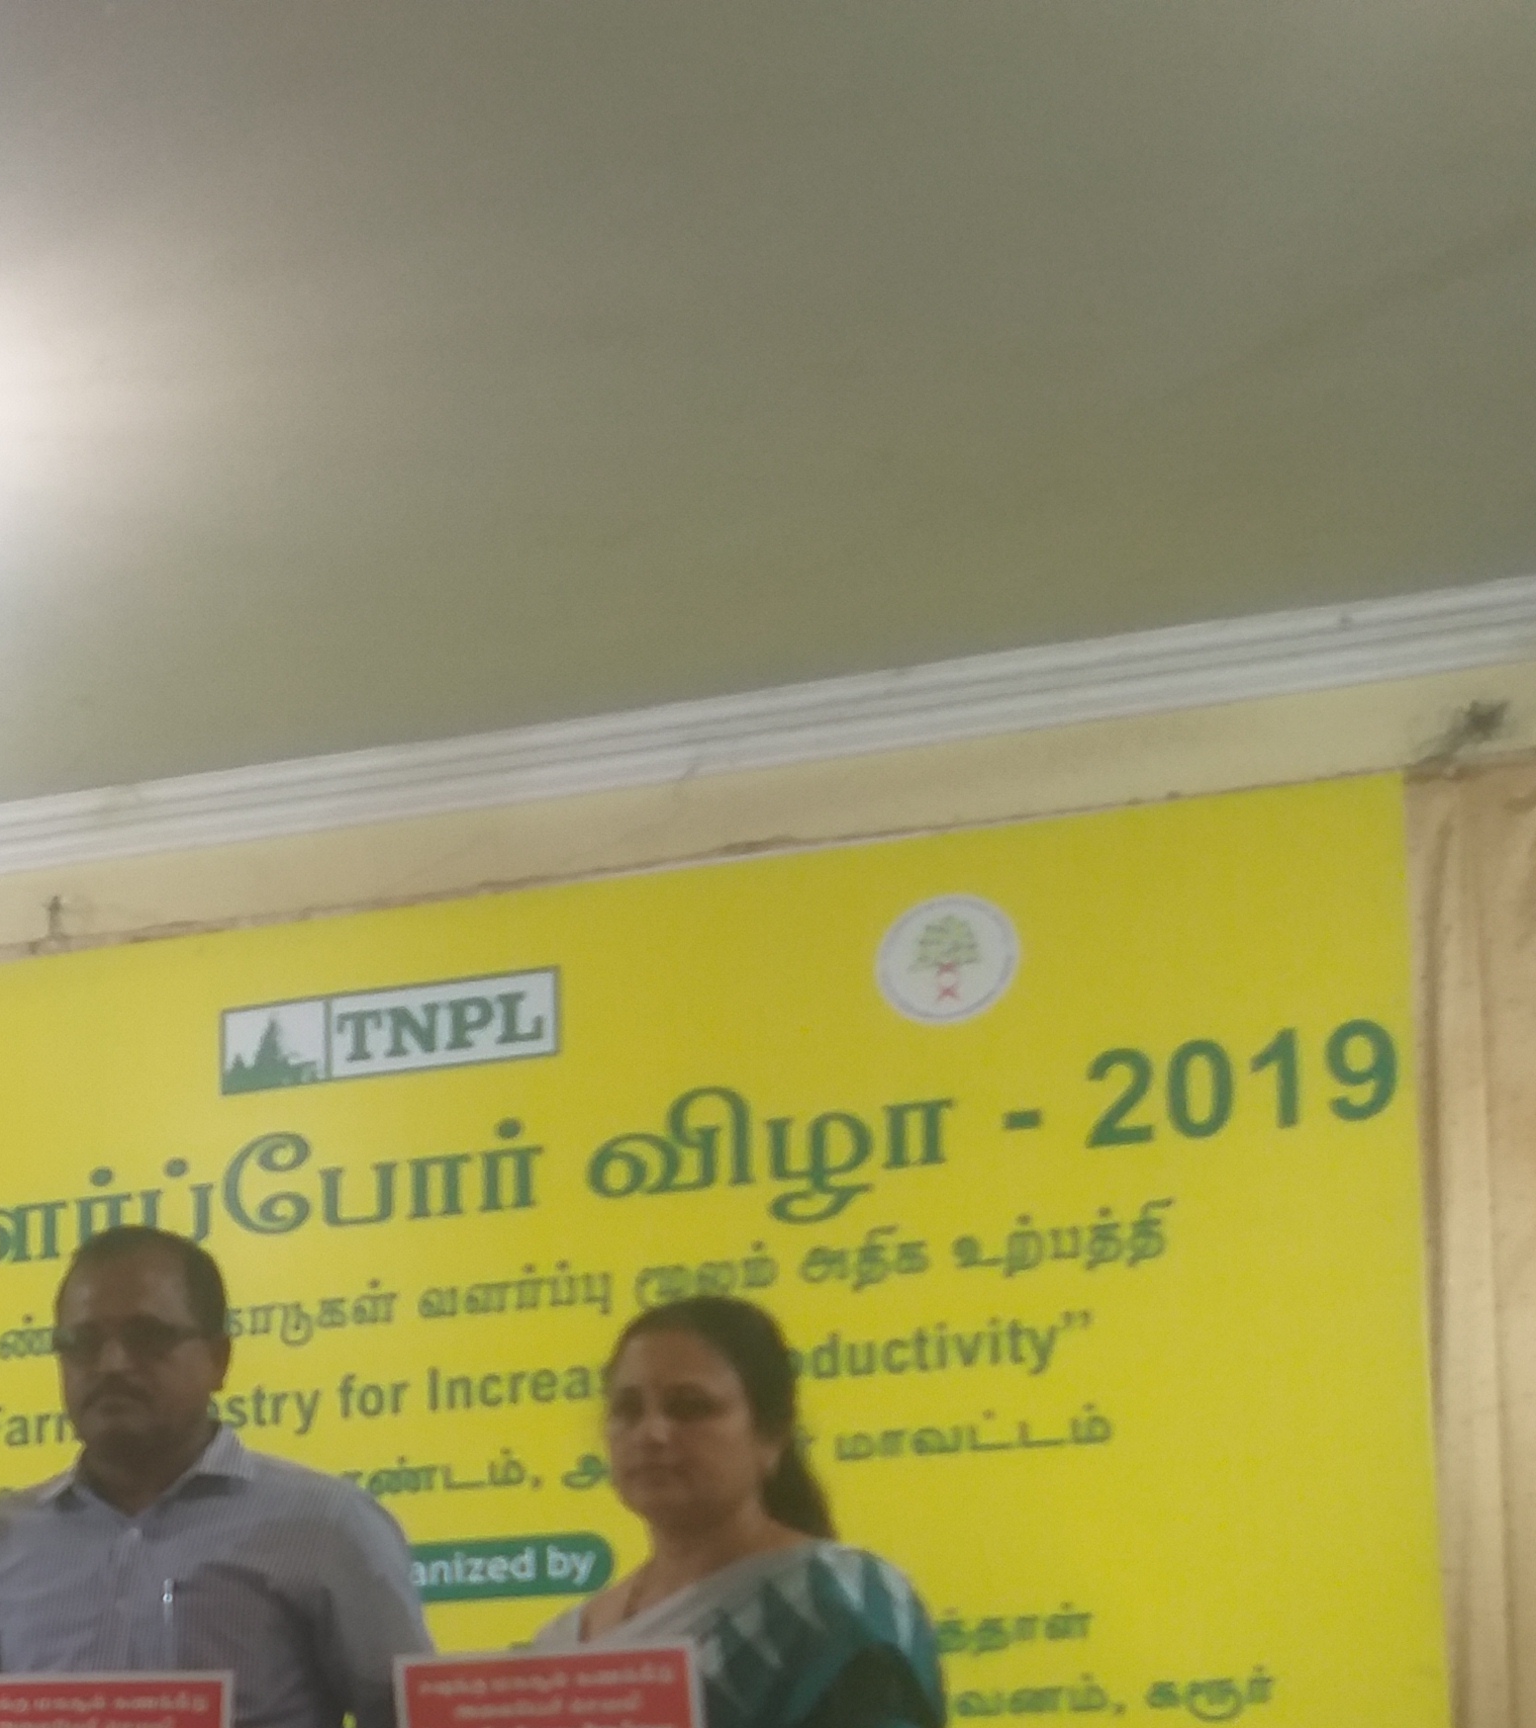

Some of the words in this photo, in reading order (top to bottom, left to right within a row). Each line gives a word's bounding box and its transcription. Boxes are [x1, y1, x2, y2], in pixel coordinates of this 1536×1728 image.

[336, 989, 545, 1063] TNPL
[584, 1085, 956, 1226] விழா
[1085, 1018, 1401, 1152] 2019
[798, 1223, 931, 1293] அதிக
[950, 1196, 1177, 1280] உற்பத்தி
[338, 1371, 409, 1420] for
[833, 1402, 1115, 1462] மாவட்டம்
[409, 1544, 537, 1588] anized
[546, 1543, 599, 1586] by
